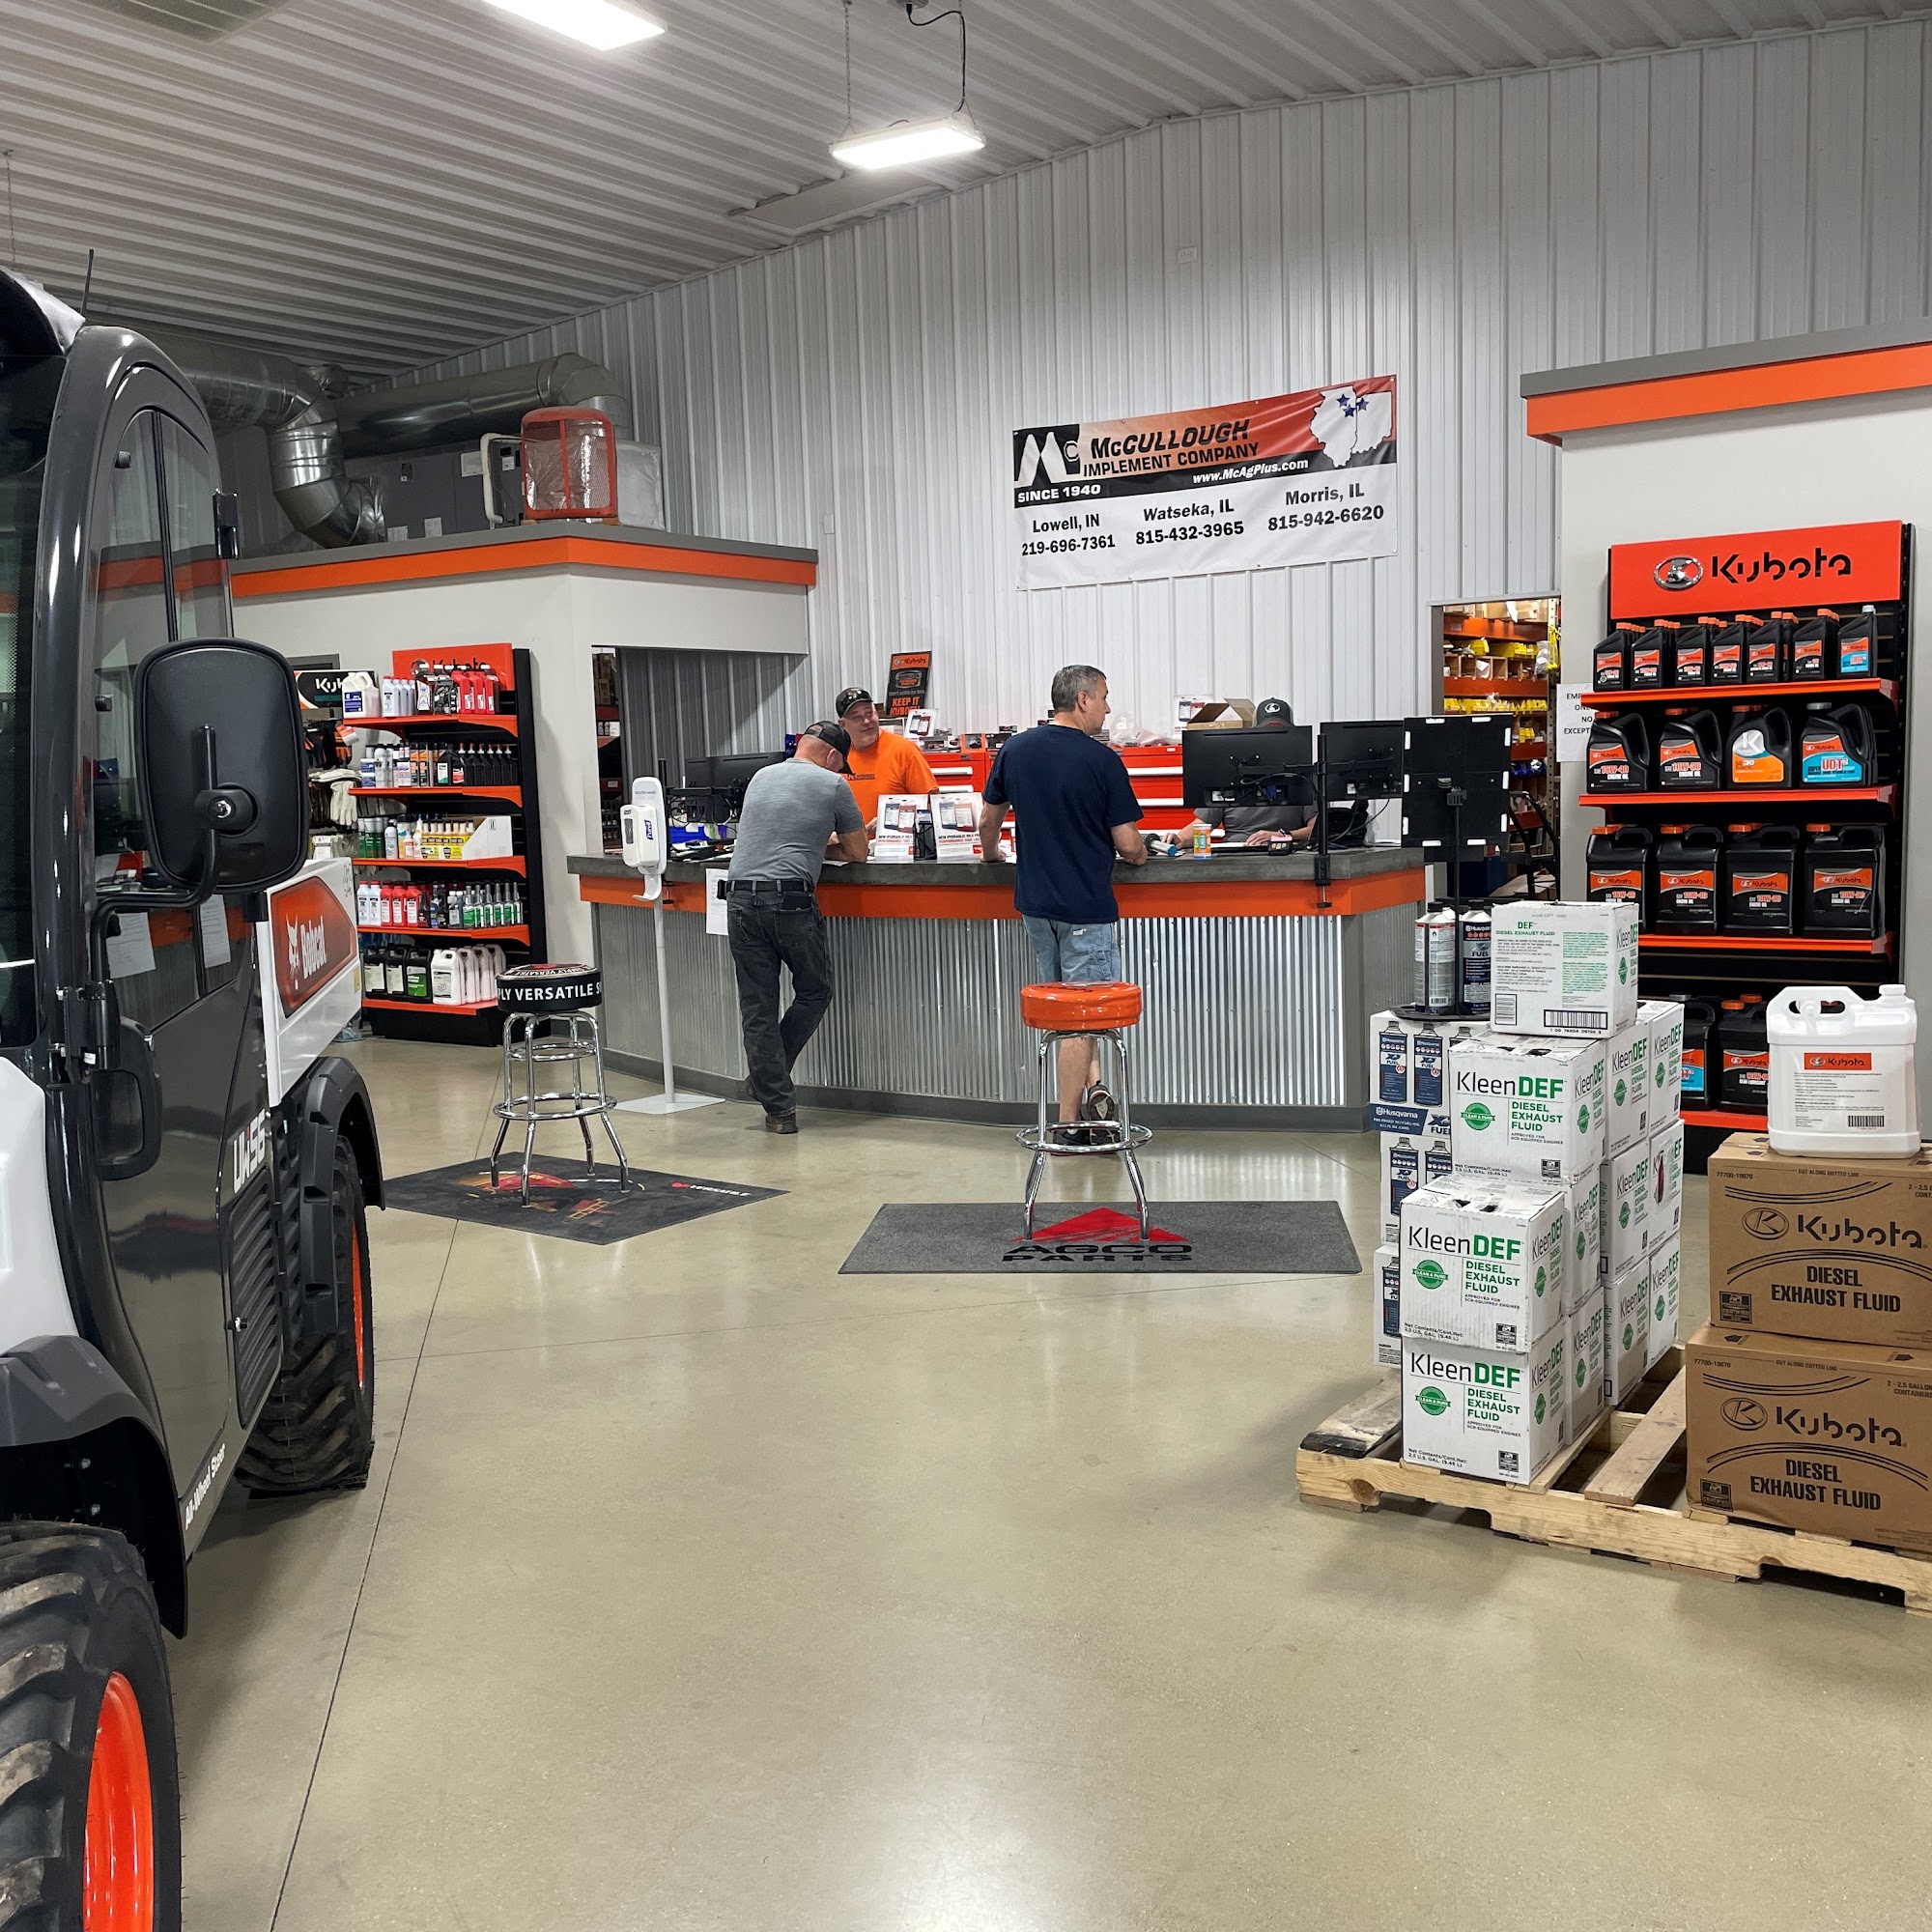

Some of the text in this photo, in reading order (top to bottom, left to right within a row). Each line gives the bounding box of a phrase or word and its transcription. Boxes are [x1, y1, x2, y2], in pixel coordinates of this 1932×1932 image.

[1091, 419, 1250, 459] McCULLOUGH
[1084, 441, 1259, 477] IMPLEMENT COMPANY
[1193, 459, 1309, 483] www.McAgPlus.com
[1017, 484, 1101, 503] SINCE 1940
[1285, 482, 1365, 506] Morris, IL
[1143, 498, 1235, 522] Watseka, IL
[1268, 504, 1384, 531] 815-942-6620
[1033, 513, 1100, 533] Lowell, IN
[1136, 521, 1244, 545] 815-432-3965
[1021, 534, 1116, 556] 219-696-7361
[1712, 548, 1851, 583] Kubota
[892, 696, 921, 707] KEEP IT
[300, 915, 327, 980] Bobcat
[515, 983, 593, 1001] VERSATILE
[1654, 1022, 1682, 1057] KleenDEF
[1611, 1037, 1648, 1073] KleenDEF
[1828, 1056, 1865, 1066] Kubota
[1457, 1071, 1564, 1099] KleenDEF
[1575, 1059, 1605, 1098] KleenDEF
[1383, 1108, 1418, 1119] Husqvarna
[1512, 1101, 1549, 1112] DIESEL
[1512, 1112, 1563, 1123] EXHAUST
[1431, 1126, 1450, 1135] FUE
[1511, 1122, 1543, 1131] FLUID
[1617, 1158, 1648, 1197] KleenDEF
[1408, 1226, 1521, 1261] KleenDEF
[1532, 1214, 1563, 1262] KleenDEF
[1798, 1214, 1923, 1250] Kubota
[1005, 1244, 1192, 1254] AGCO
[1465, 1271, 1520, 1287] EXHAUST
[1466, 1261, 1506, 1274] DIESEL
[1652, 1250, 1679, 1292] KleenDEF
[1806, 1265, 1862, 1287] DIESEL
[1465, 1282, 1498, 1293] FLUID
[1620, 1276, 1648, 1320] KleenDEF
[1771, 1284, 1901, 1313] EXHAUST FLUID
[1574, 1307, 1603, 1355] KleenDEF
[1410, 1351, 1520, 1388] KleenDEF
[1532, 1338, 1563, 1389] KleenDEF
[1467, 1399, 1520, 1414] EXHAUST
[1468, 1388, 1507, 1403] DIESEL
[1467, 1409, 1499, 1421] FLUID
[1776, 1406, 1902, 1447] Kubota
[1785, 1459, 1842, 1483] DIESEL
[185, 1464, 211, 1530] All-Wheel
[1750, 1475, 1881, 1510] EXHAUST FLUID
